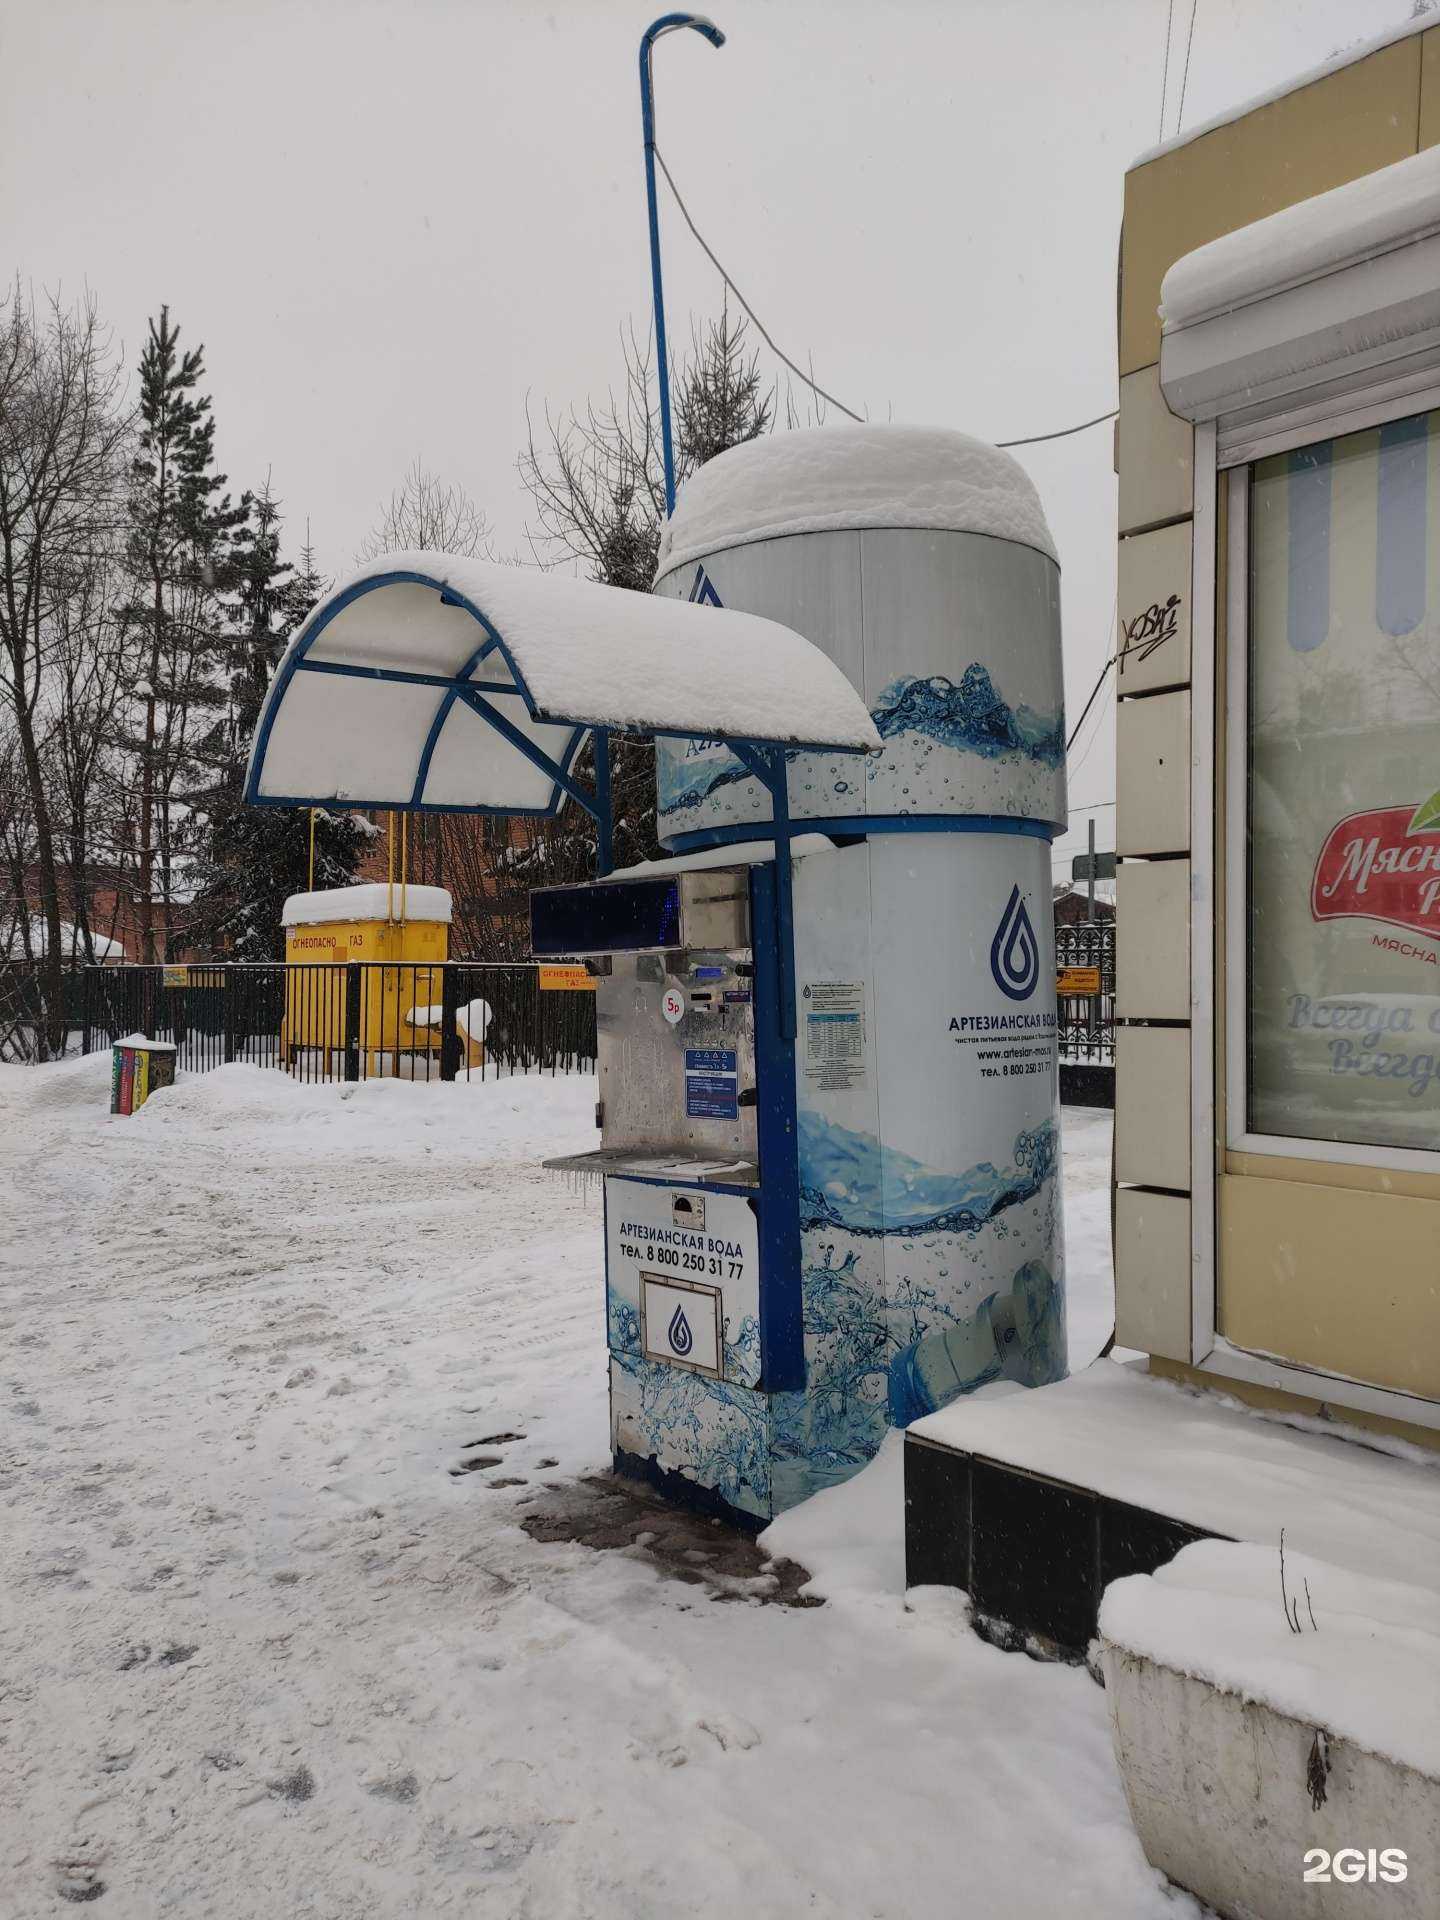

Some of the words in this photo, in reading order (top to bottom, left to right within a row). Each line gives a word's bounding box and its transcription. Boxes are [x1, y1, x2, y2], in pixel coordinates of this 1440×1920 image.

[292, 936, 337, 949] ОГНЕОПАСНО
[349, 934, 363, 947] ГАЗ
[949, 1014, 1041, 1031] АРТЕЗИАНСКАЯ
[981, 1068, 1001, 1077] тел.
[1003, 1065, 1008, 1076] 8
[1010, 1064, 1024, 1075] 800
[1025, 1063, 1036, 1074] 250
[1037, 1062, 1044, 1073] 31
[1327, 1038, 1440, 1097] Всегд
[620, 1222, 704, 1251] АРТЕЗИАНСКАЯ
[708, 1238, 743, 1259] ВОДА
[620, 1243, 643, 1259] тел.
[647, 1245, 654, 1261] 8
[657, 1247, 679, 1266] 800
[683, 1253, 705, 1272] 250
[709, 1258, 722, 1276] 31
[728, 1262, 744, 1280] 77
